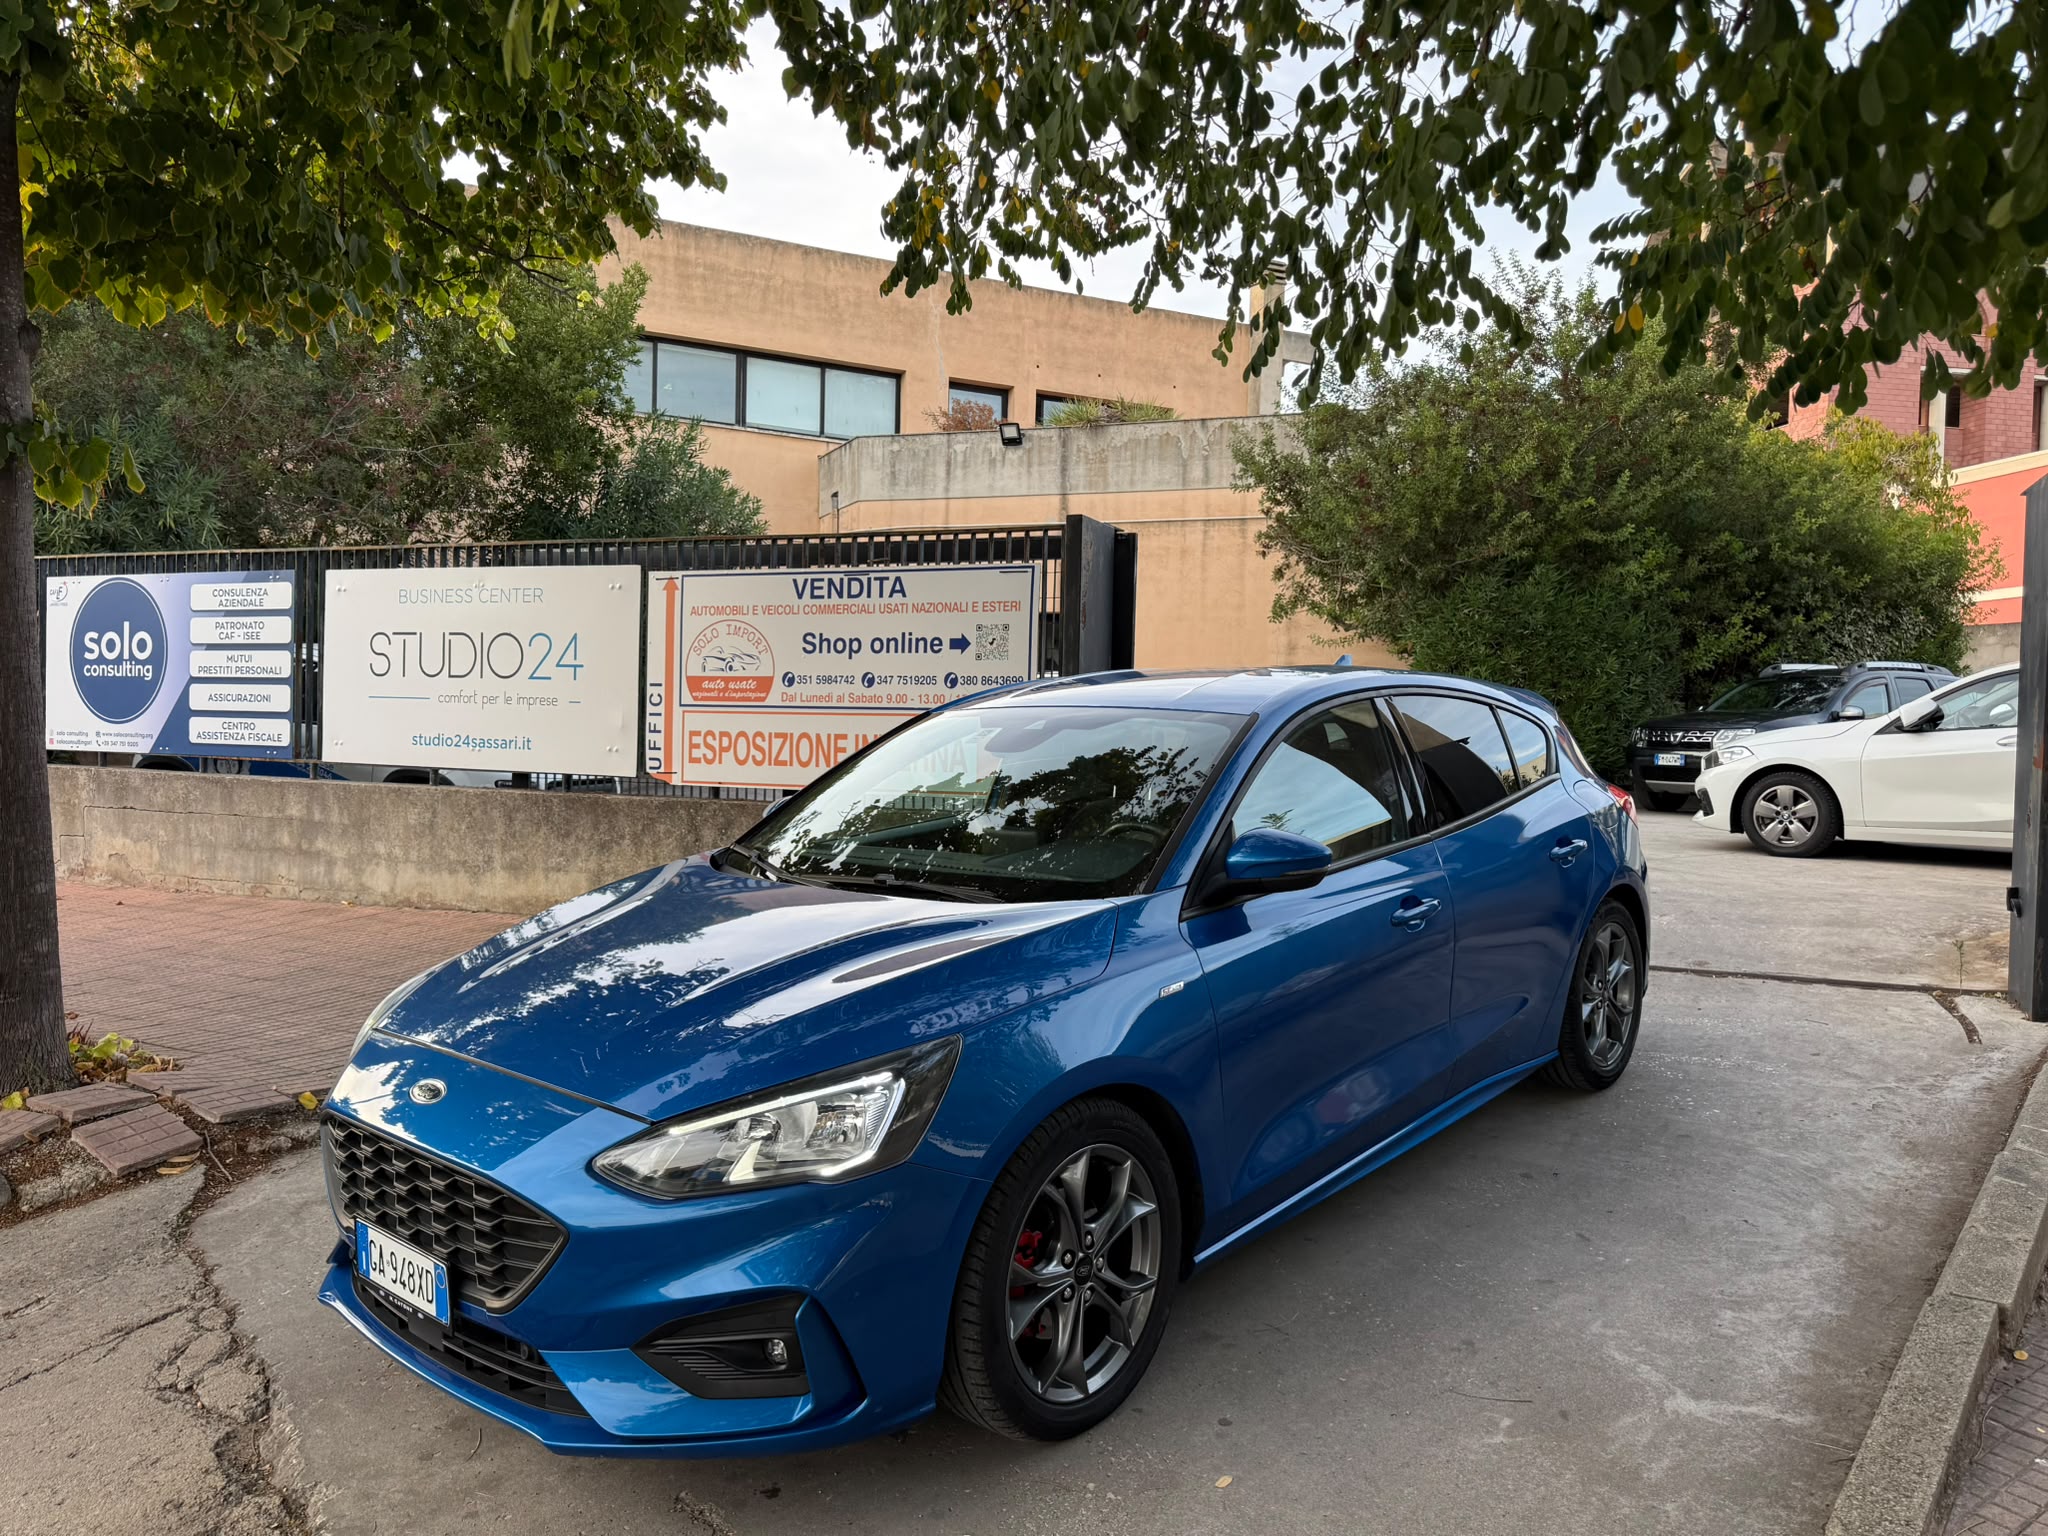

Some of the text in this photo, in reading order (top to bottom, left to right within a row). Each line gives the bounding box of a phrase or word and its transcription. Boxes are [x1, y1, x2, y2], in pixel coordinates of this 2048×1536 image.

[212, 588, 269, 597] CONSULENZA
[793, 576, 907, 600] VENDITA
[398, 587, 544, 604] BUSINESS CENTER
[218, 598, 264, 608] AZIENDALE
[690, 600, 1021, 616] AUTOMOBILI E VEICOLI COMMERCIALI USATI NAZIONALI E ESTERI
[215, 621, 265, 630] PATRONATO
[83, 621, 153, 660] solo
[218, 631, 235, 641] CAF
[243, 631, 261, 641] ISEE
[693, 624, 768, 656] SOLO IMPORT
[802, 632, 943, 659] Shop online
[226, 654, 252, 663] MUTUI
[369, 632, 584, 680] STUDIO24
[84, 661, 152, 680] consulting
[198, 665, 282, 675] PRESTITI PERSONALI
[702, 679, 757, 689] auto usate
[796, 674, 855, 685] 351 5984742
[876, 674, 937, 686] 347 7519205
[959, 675, 977, 686] 380
[208, 693, 271, 703] ASSICURAZIONI
[438, 690, 559, 710] comfort per le imprese
[781, 692, 797, 703] Dal
[836, 692, 845, 704] al
[847, 693, 883, 704] Sabato
[886, 693, 907, 704] 9.00
[918, 694, 946, 704] 13.00
[221, 721, 256, 731] CENTRO
[648, 682, 662, 771] UFFICI
[196, 731, 283, 742] ASSISTENZA FISCALE
[411, 733, 532, 751] studio24sassari.it
[688, 730, 847, 769] ESPOSIZIONE
[369, 1239, 434, 1303] GA 948XD
